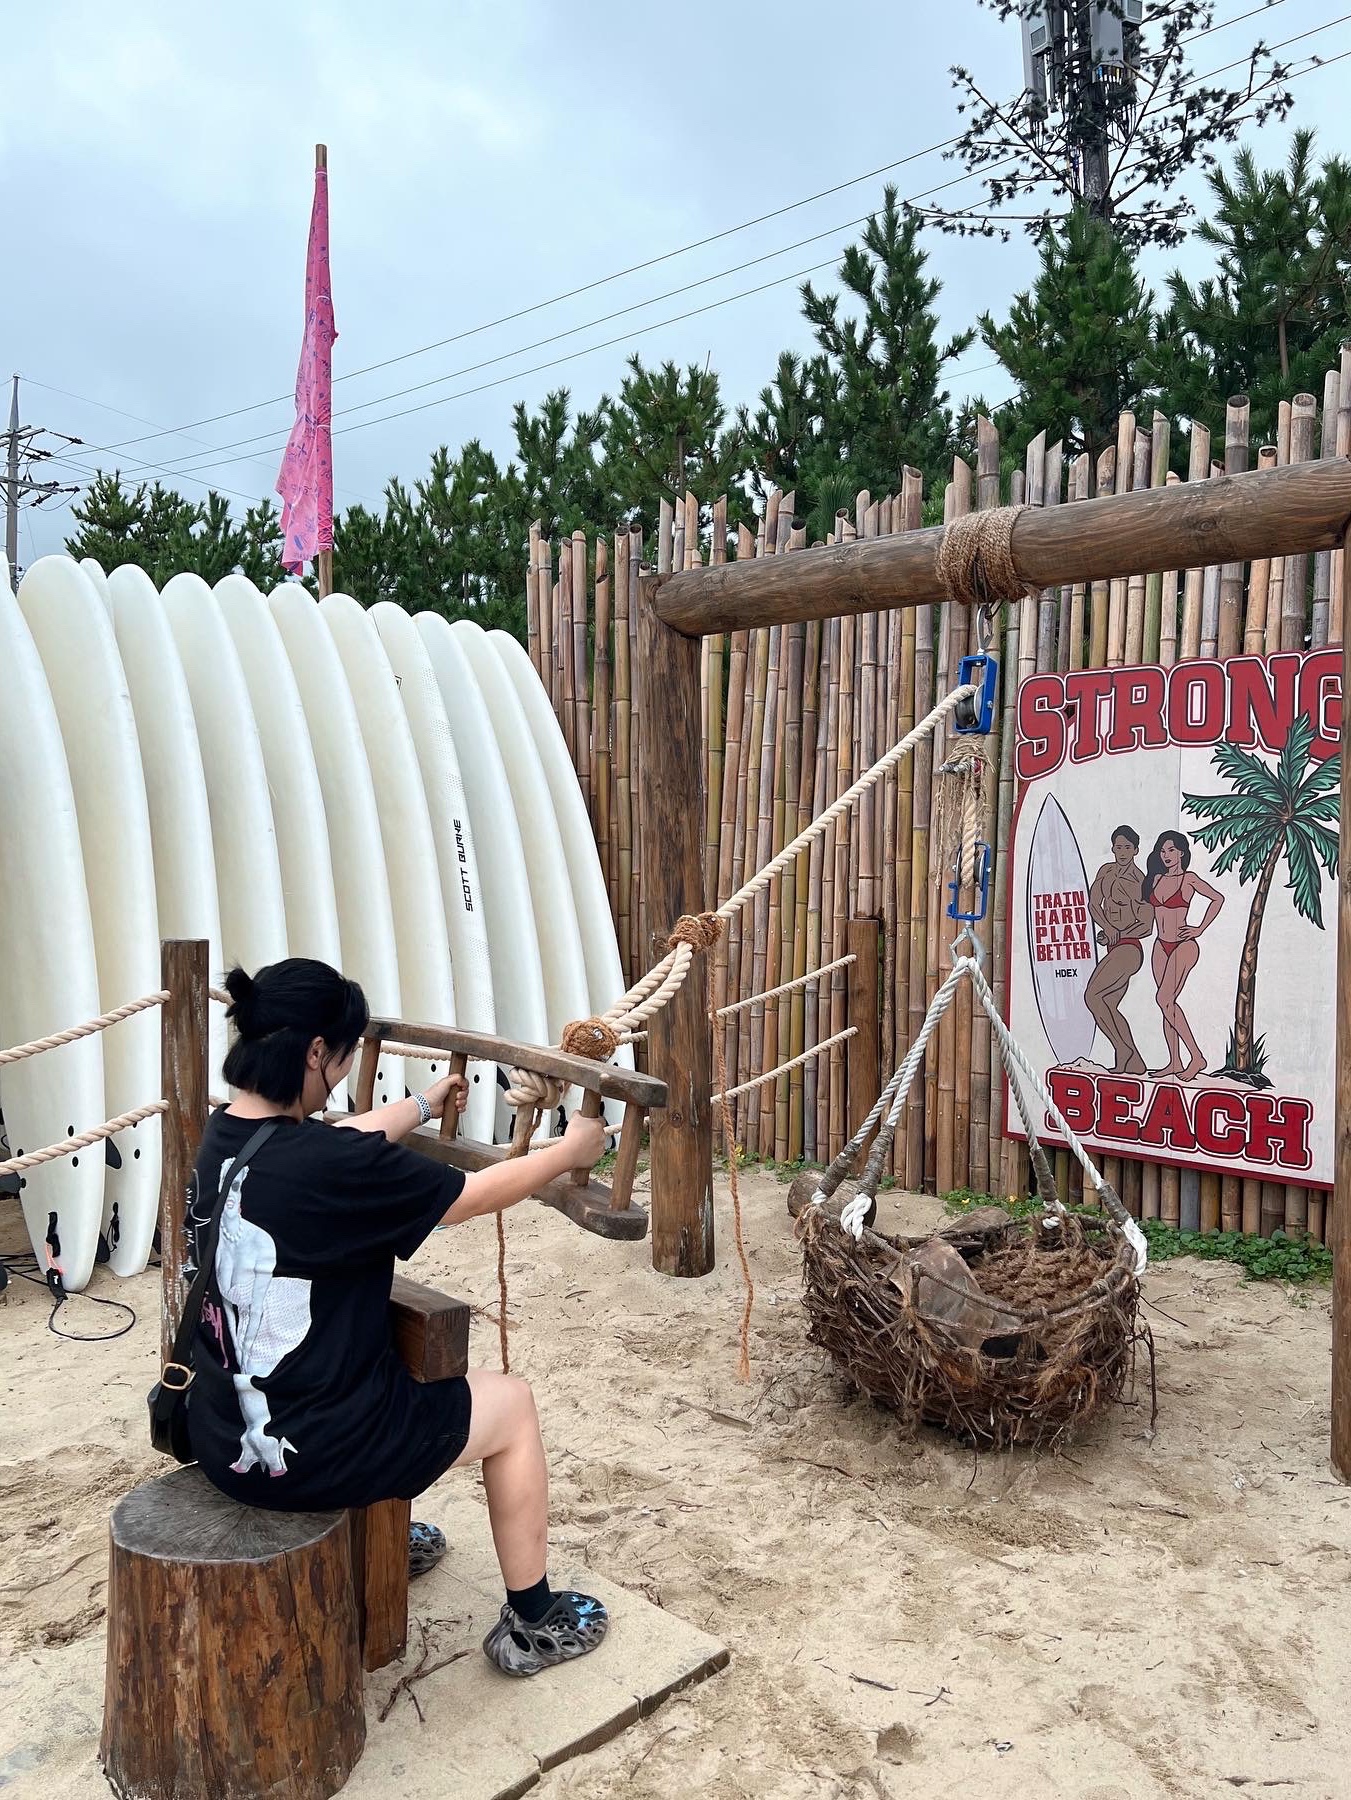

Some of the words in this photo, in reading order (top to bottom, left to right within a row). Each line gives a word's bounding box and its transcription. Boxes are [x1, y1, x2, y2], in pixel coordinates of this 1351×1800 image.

[453, 818, 467, 862] BURKE
[460, 867, 473, 912] SCOTT
[1033, 890, 1085, 910] TRAIN
[1035, 906, 1087, 926] HARD
[1036, 923, 1087, 944] PLAY
[1036, 941, 1091, 962] BETTER
[1055, 968, 1078, 978] HDEX
[1046, 1069, 1312, 1170] BEACH
